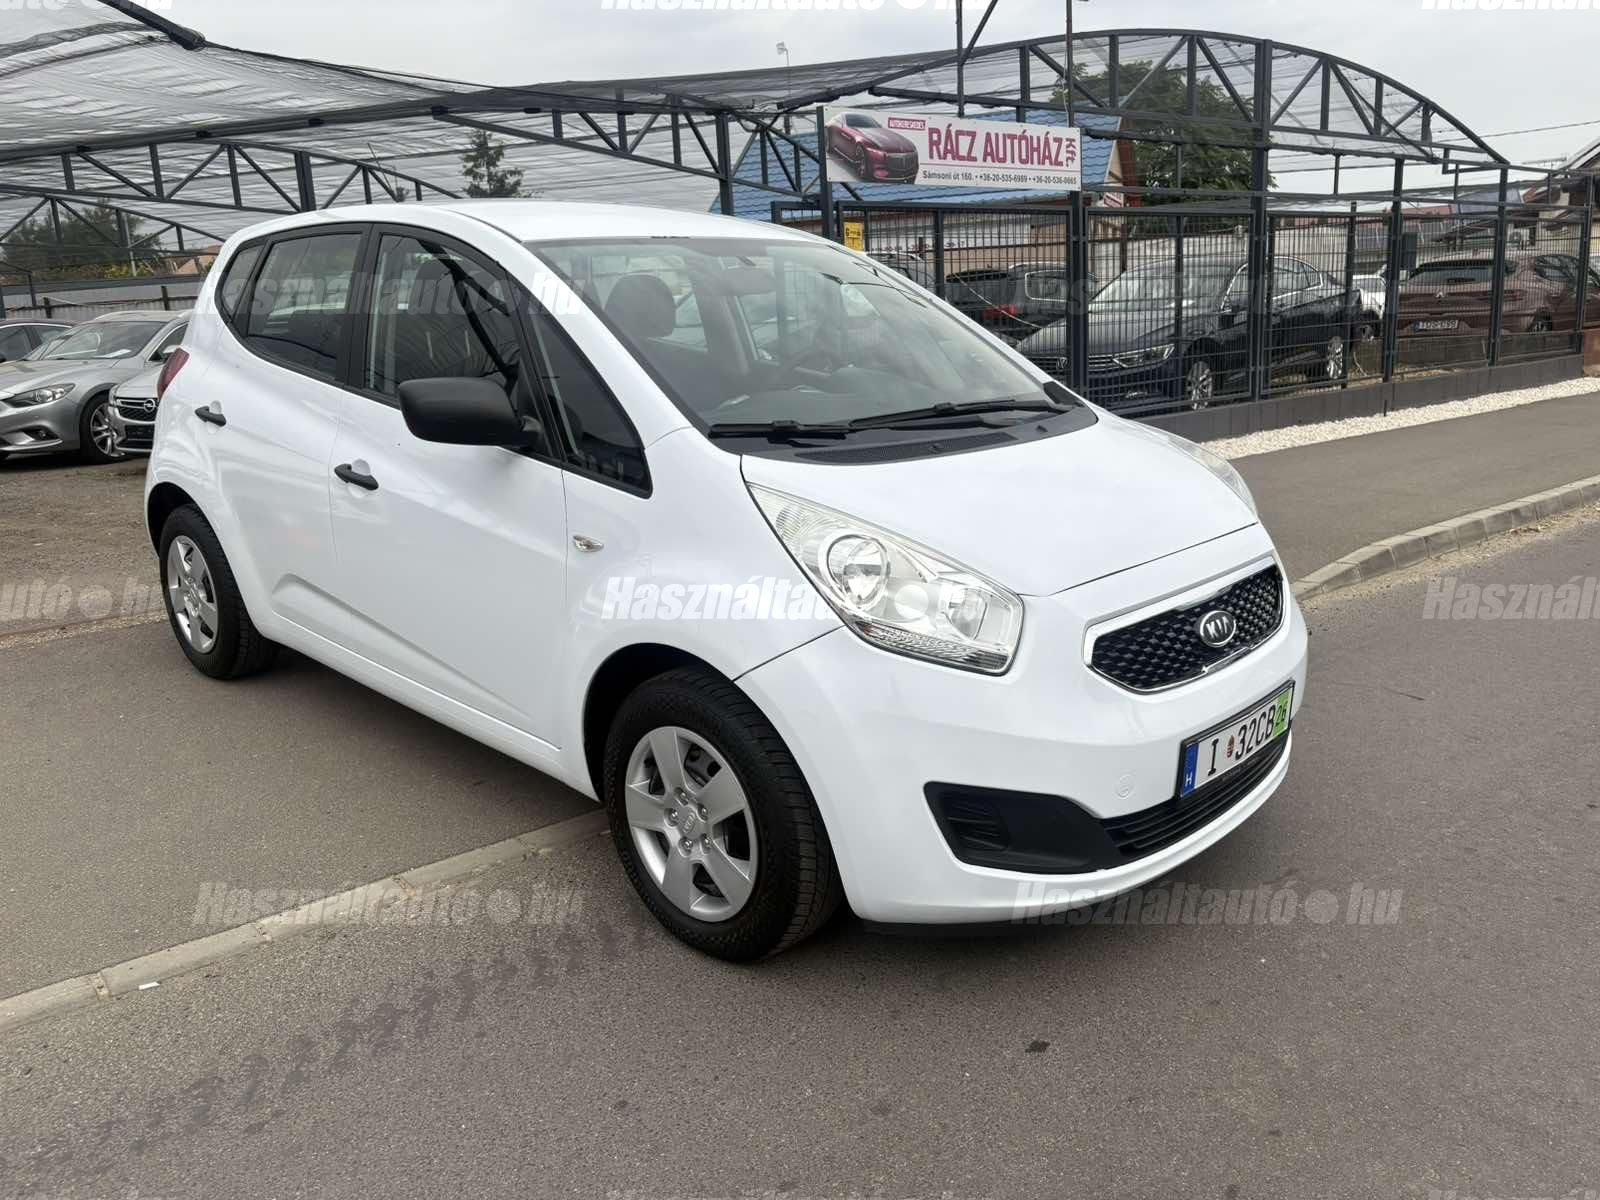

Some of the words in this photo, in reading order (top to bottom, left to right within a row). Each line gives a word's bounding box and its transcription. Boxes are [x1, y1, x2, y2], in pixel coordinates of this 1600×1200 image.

[928, 123, 977, 162] RÁCZ
[983, 129, 1063, 167] AUTÓHÁZ
[1235, 705, 1276, 761] 32CB
